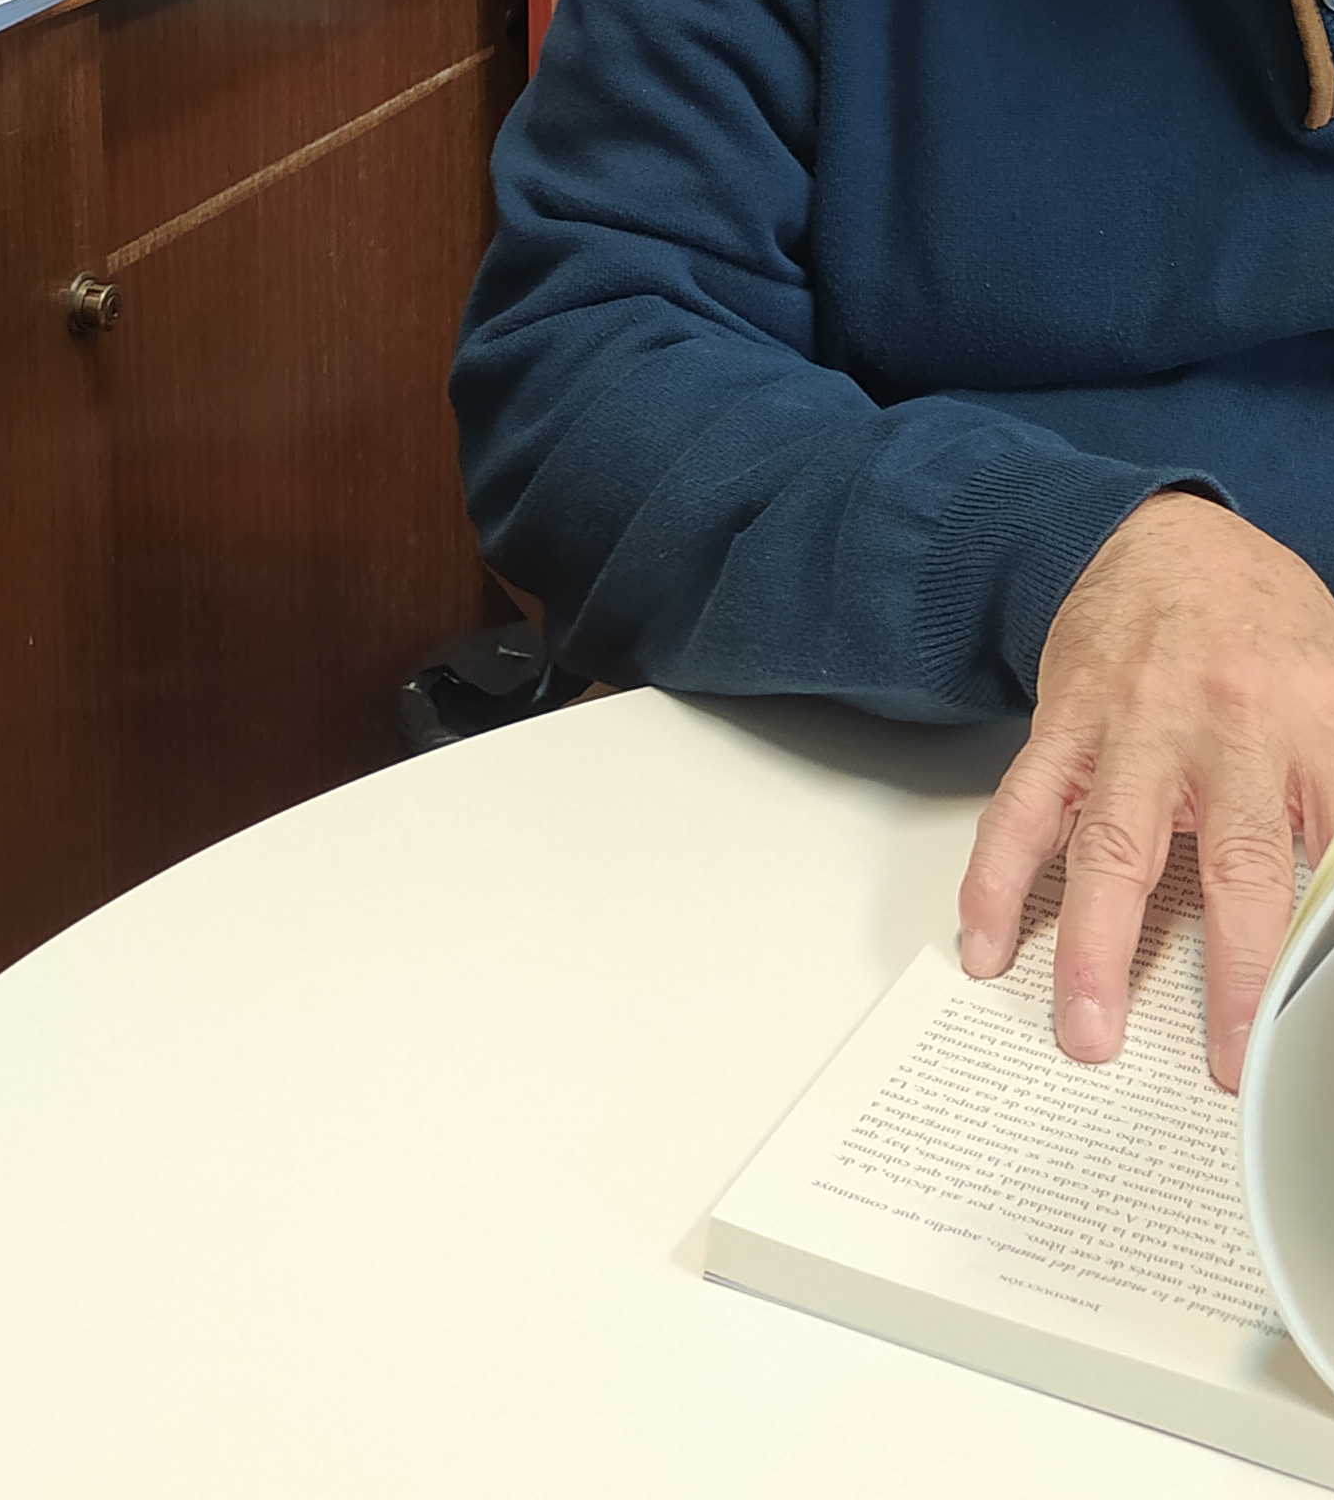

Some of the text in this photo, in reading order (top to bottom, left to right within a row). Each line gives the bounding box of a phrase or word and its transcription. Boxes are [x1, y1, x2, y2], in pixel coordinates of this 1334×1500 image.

[884, 1106, 962, 1138] integrados
[859, 1113, 983, 1161] intersubjetividad
[879, 1088, 1242, 1204] omunidad, para que interactúen, para que creen
[966, 1133, 1019, 1154] sientan
[842, 1139, 911, 1167] cubrimos
[986, 1155, 1001, 1167] la
[1003, 1159, 1014, 1168] y
[1024, 1151, 1039, 1160] se
[1046, 1157, 1075, 1170] que
[913, 1164, 942, 1177] que
[1014, 1164, 1049, 1178] cual
[1081, 1167, 1117, 1183] para
[851, 1127, 1241, 1254] de sociedad. A esa humanidad, en síntesis, hay que
[944, 1175, 1002, 1196] aquello
[1052, 1175, 1089, 1190] cada
[1090, 1187, 1110, 1199] de
[1122, 1180, 1193, 1209] humanos
[1016, 1197, 1108, 1233] humanidad
[1111, 1193, 1209, 1226] subjetividad
[1200, 1202, 1245, 1221] rados
[830, 1155, 1265, 1295] itamente, también es la intención, por así decirlo, de de-
[1112, 1225, 1127, 1239] la
[1213, 1222, 1228, 1235] la
[1131, 1231, 1167, 1248] toda
[811, 1179, 1291, 1341] teligibilidad a lo material del mundo, aquello que constituye
[1171, 1243, 1235, 1267] páginas
[1025, 1232, 1268, 1317] latente de interés de este libro.
[1239, 1264, 1262, 1277] tas
[998, 1273, 1101, 1313] INTRODUCCIÓN
